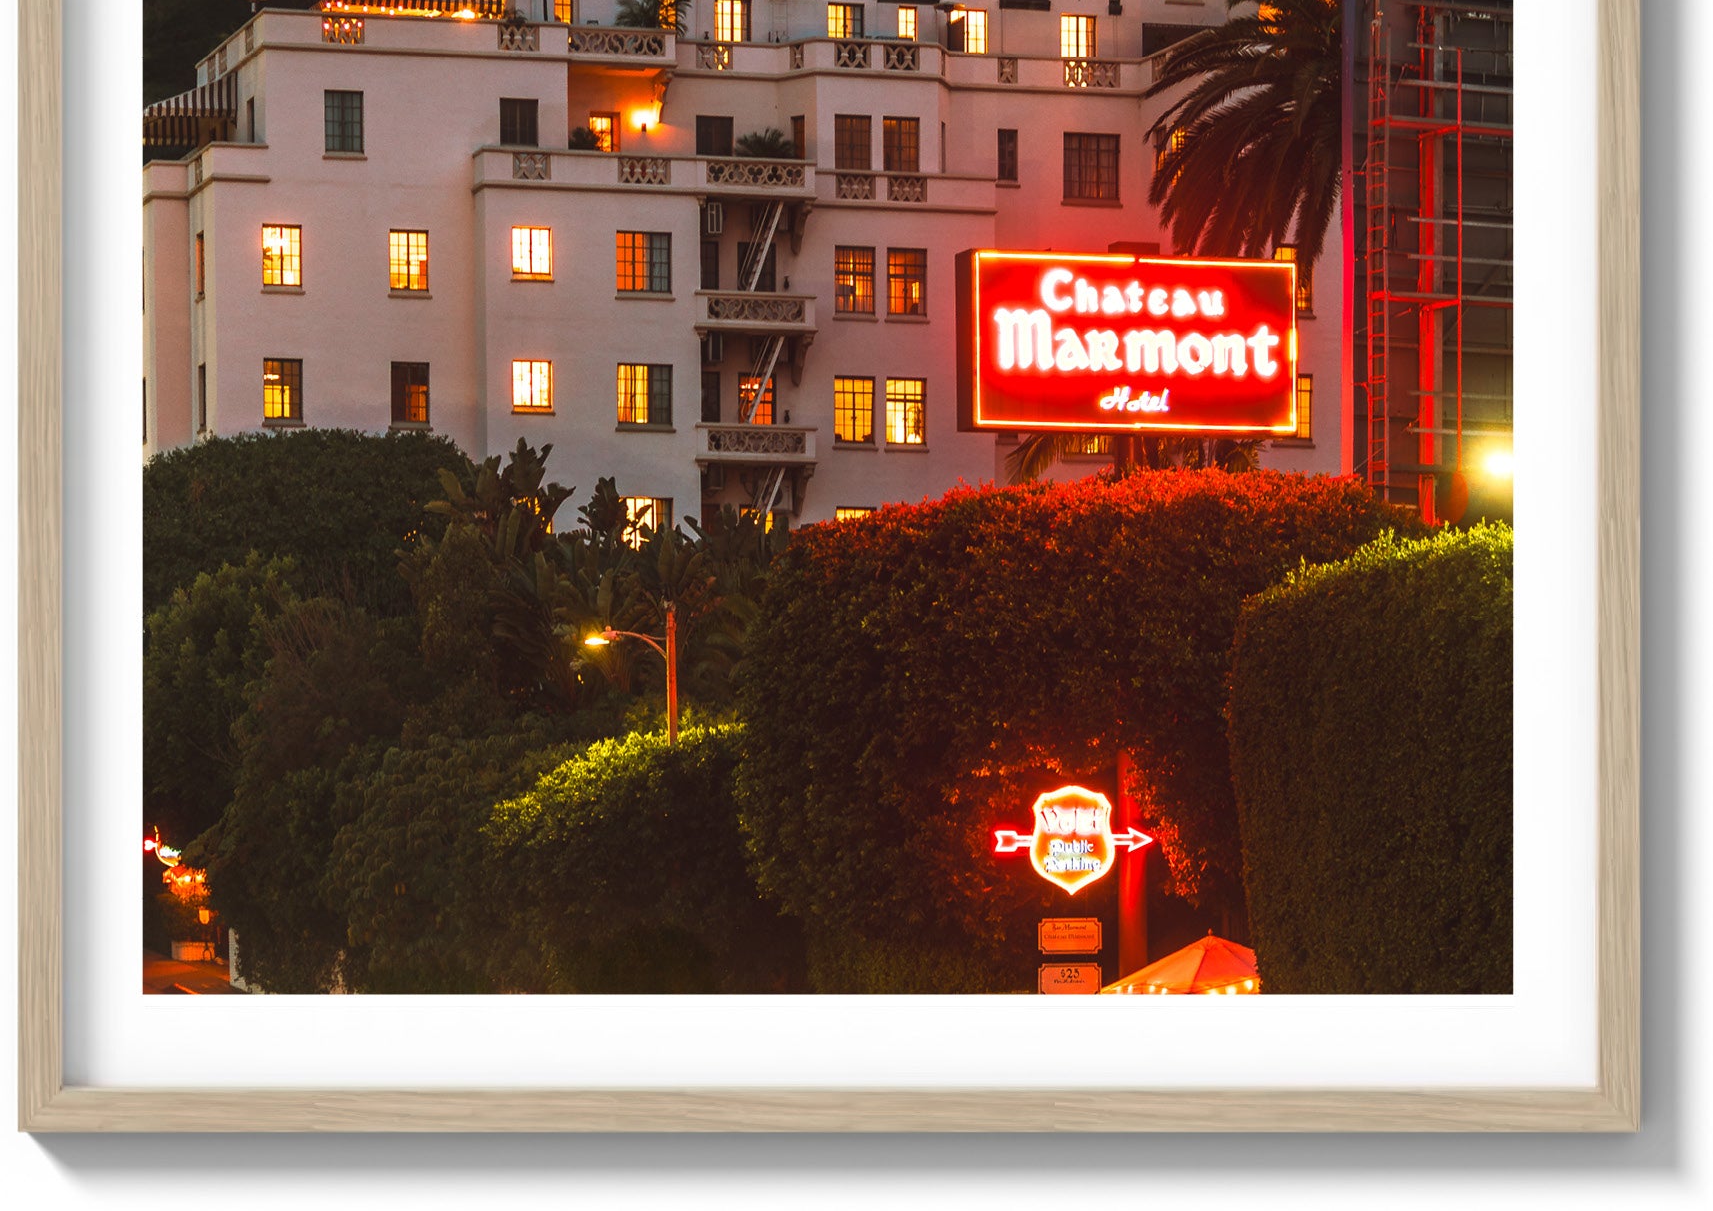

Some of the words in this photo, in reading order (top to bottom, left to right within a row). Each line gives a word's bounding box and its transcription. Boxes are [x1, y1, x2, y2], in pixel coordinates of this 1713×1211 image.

[1041, 268, 1223, 316] Chateau
[994, 308, 1279, 377] Marmont
[1100, 387, 1170, 412] Hotel
[1049, 839, 1094, 856] Public
[1060, 968, 1080, 979] $25
